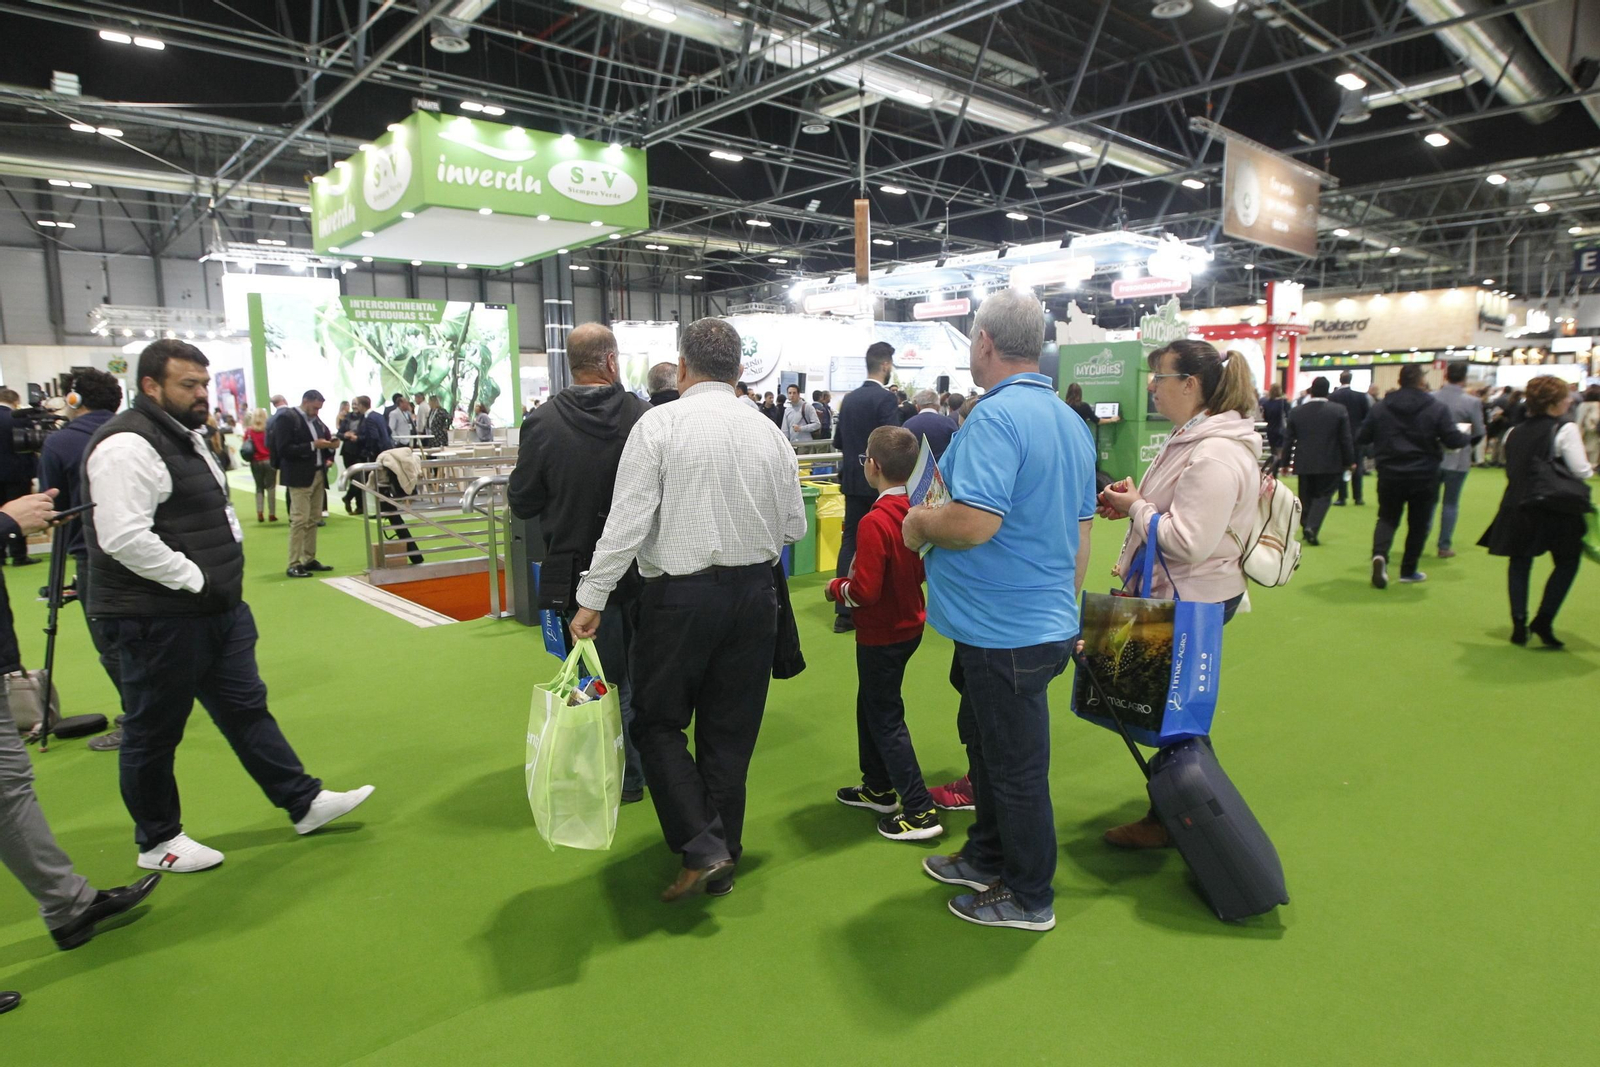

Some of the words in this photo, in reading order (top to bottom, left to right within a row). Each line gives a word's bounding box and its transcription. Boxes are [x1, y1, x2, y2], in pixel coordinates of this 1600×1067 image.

[567, 186, 598, 197] Siempre
[600, 190, 621, 199] Verde
[1581, 251, 1597, 272] E
[350, 299, 438, 312] INTERCONTINENTAL
[355, 309, 367, 319] DE
[369, 310, 416, 320] VERDURAS
[418, 311, 434, 321] S.L.
[1312, 317, 1368, 333] Platero
[1177, 632, 1187, 659] AGRO
[1127, 701, 1152, 714] AGRO
